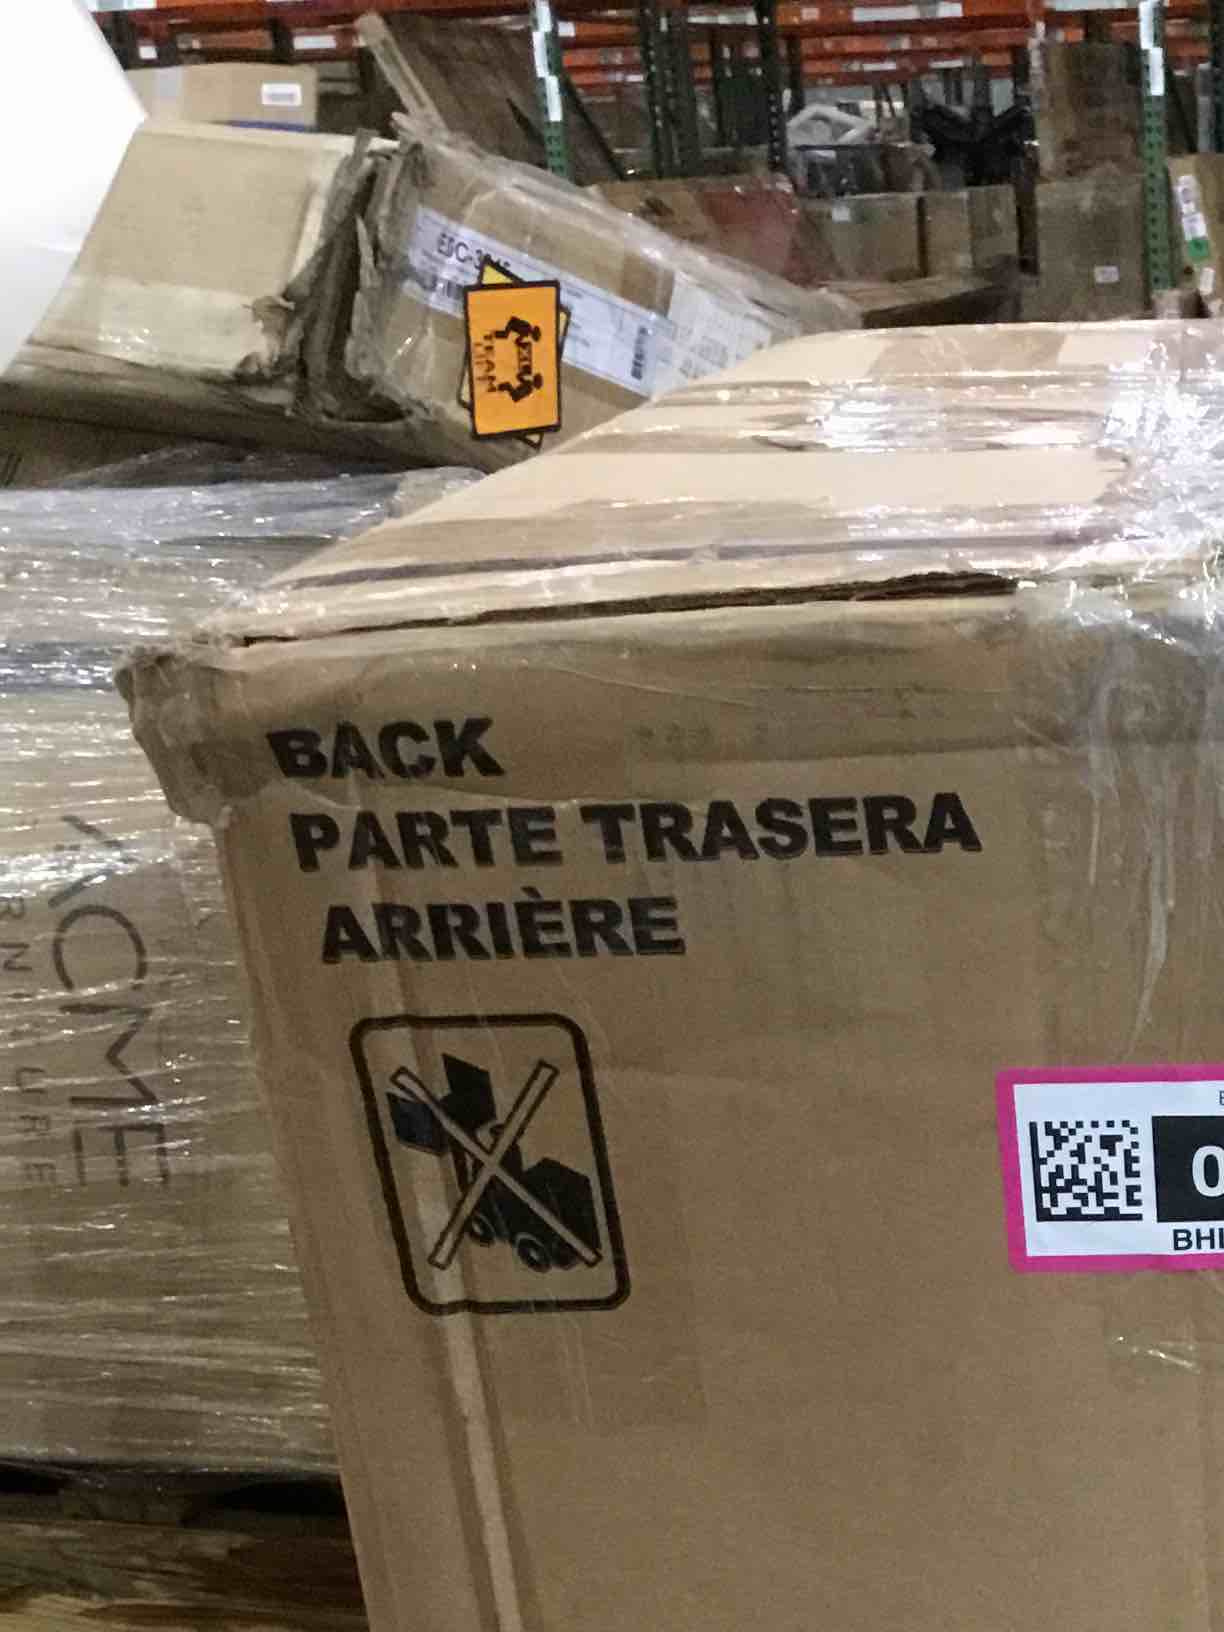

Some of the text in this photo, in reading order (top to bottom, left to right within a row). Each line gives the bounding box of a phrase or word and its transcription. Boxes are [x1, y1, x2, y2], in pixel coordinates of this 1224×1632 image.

[265, 718, 505, 779] BACK
[289, 792, 982, 872] PARTE TRASERA
[321, 886, 686, 964] ARRIÈRE
